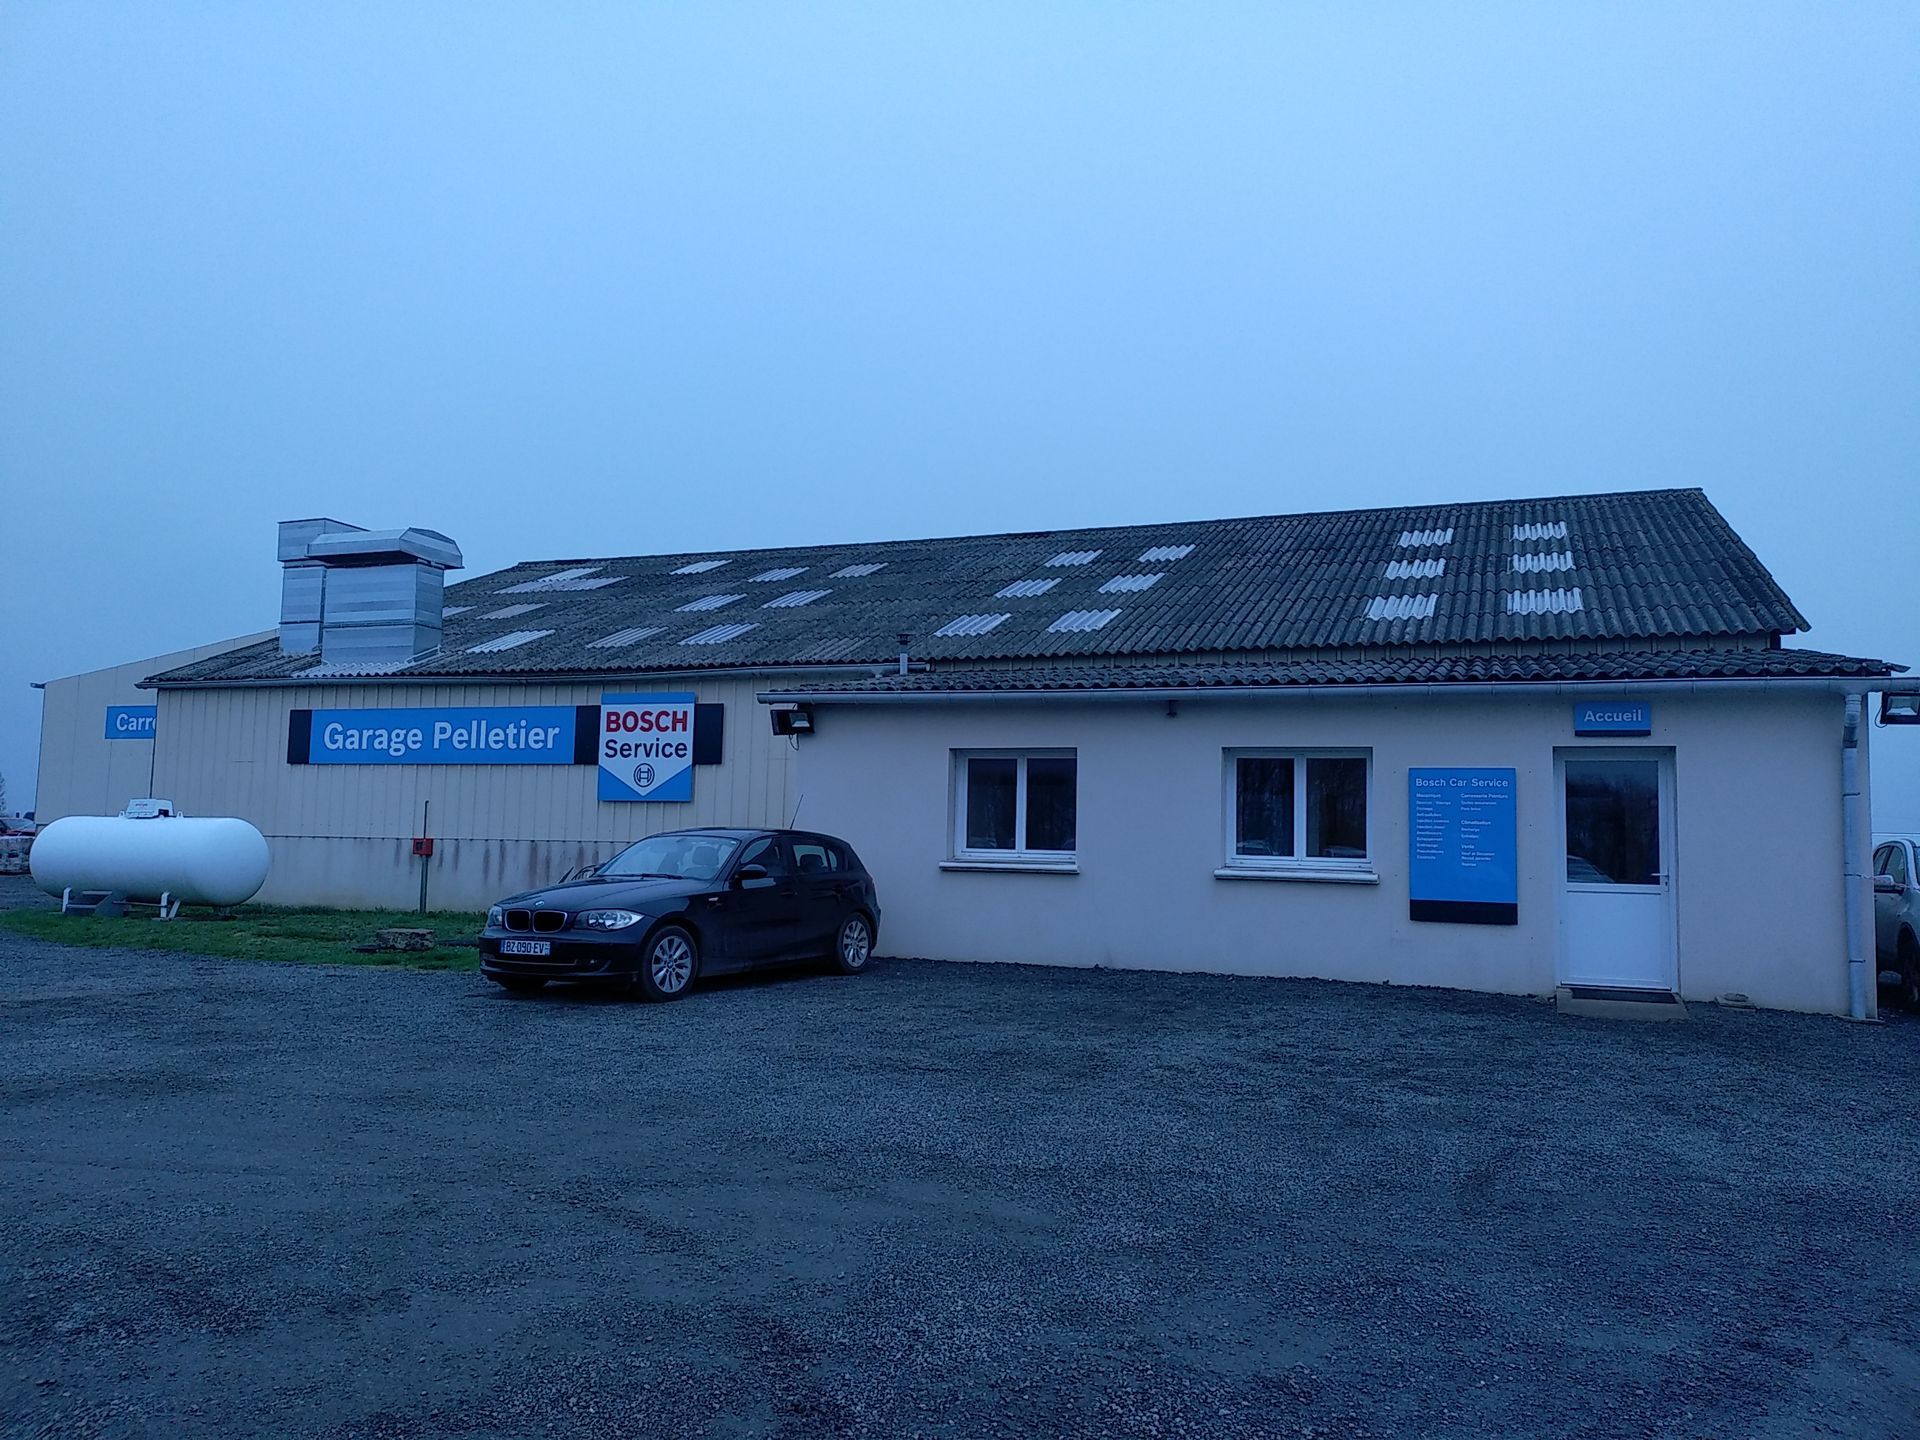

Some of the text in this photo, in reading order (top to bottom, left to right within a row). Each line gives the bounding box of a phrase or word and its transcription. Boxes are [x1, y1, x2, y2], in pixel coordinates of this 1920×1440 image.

[605, 710, 688, 732] BOSCH
[1583, 709, 1642, 722] Accueil
[323, 719, 560, 757] Garage Pelletier
[604, 737, 688, 758] Service
[1415, 778, 1509, 787] Bosch Car Service
